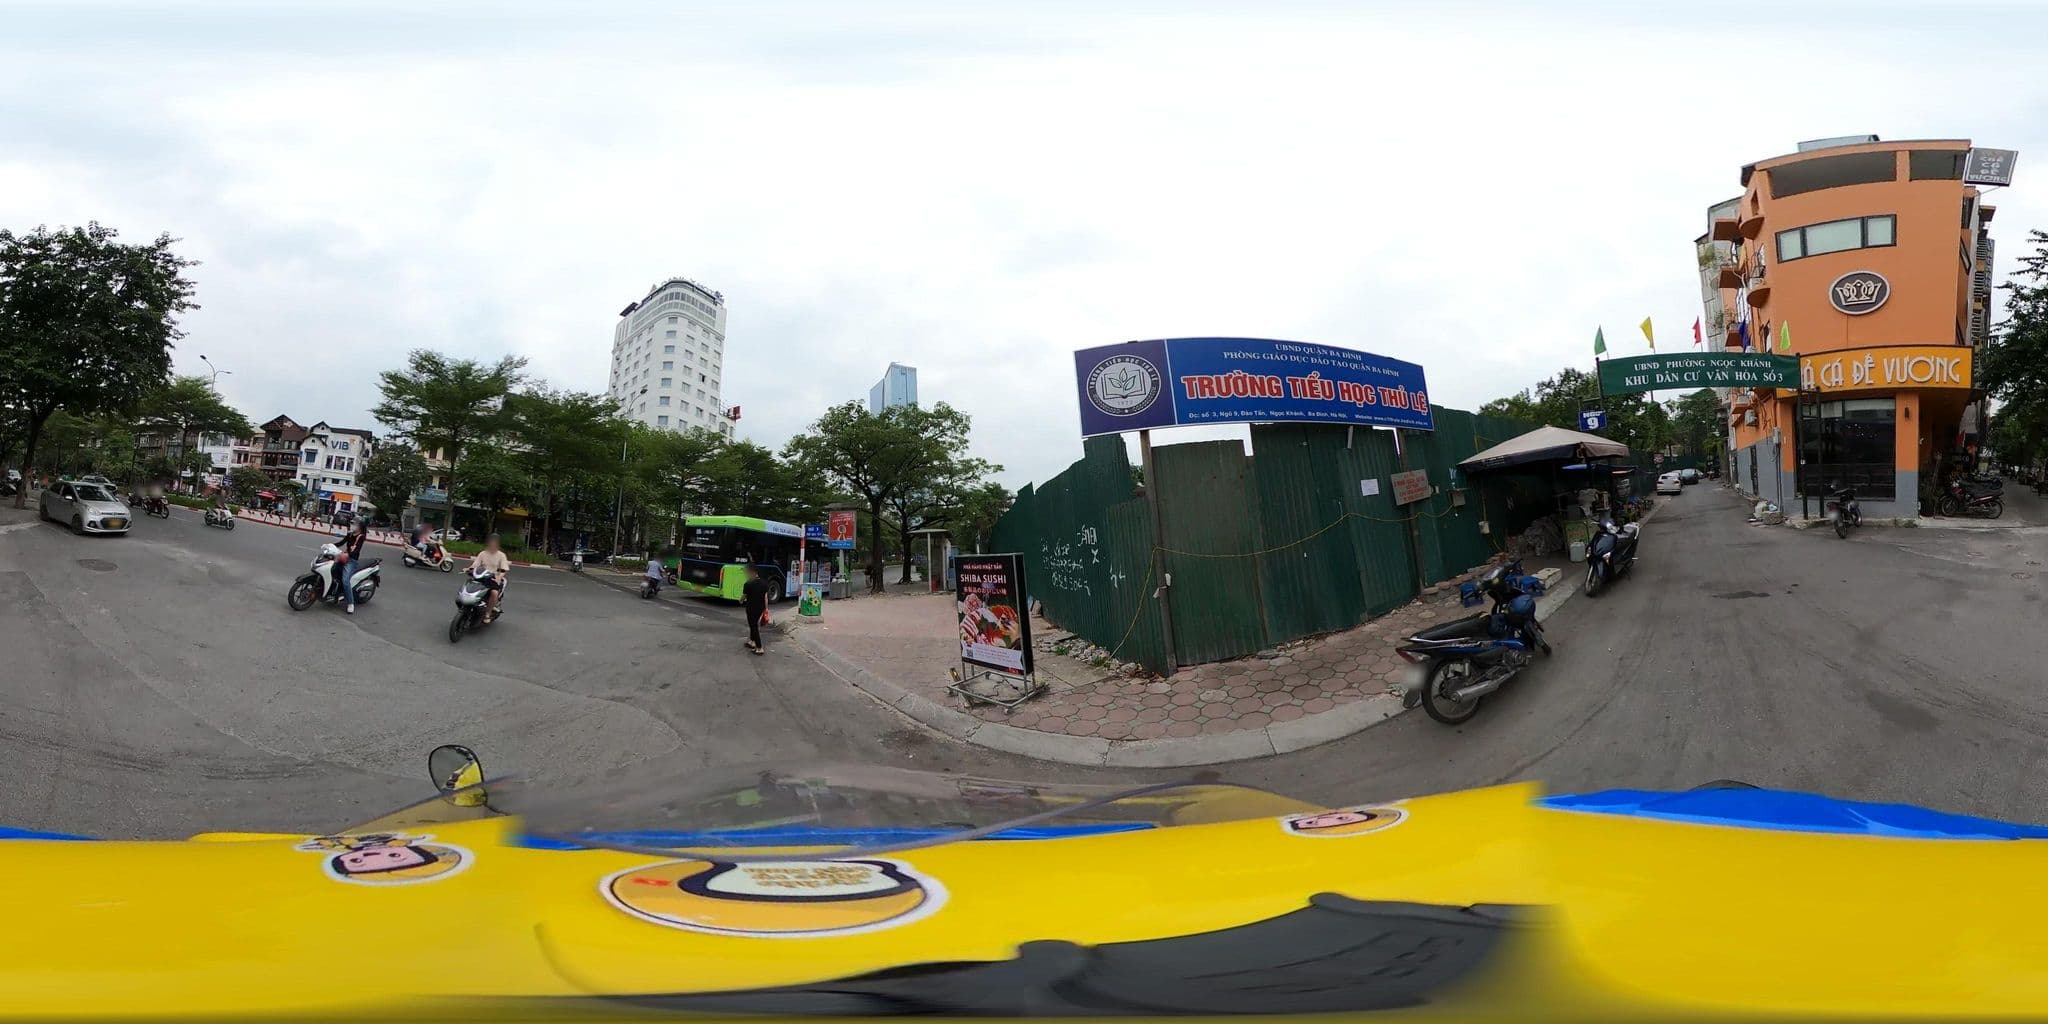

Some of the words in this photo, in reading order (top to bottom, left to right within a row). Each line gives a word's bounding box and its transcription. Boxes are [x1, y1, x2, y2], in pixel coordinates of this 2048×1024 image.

[1275, 343, 1302, 352] UBND
[1303, 346, 1328, 355] QUẬN
[1222, 350, 1260, 360] PHÒNG
[1262, 351, 1288, 361] GIÁO
[1666, 359, 1705, 368] PHƯỜNG
[1710, 359, 1735, 368] NGỌC
[1740, 358, 1772, 368] KHÁNH
[1820, 357, 1844, 387] CÁ
[1852, 352, 1876, 385] ĐẾ
[1883, 354, 1961, 384] VƯƠNG
[1625, 374, 1650, 386] KHU
[1656, 370, 1679, 383] DÂN
[1683, 370, 1701, 381] CƯ
[1707, 370, 1729, 381] VĂN
[1763, 368, 1777, 382] SỐ
[1777, 374, 1783, 382] 3
[1181, 369, 1284, 400] TRƯỜNG
[1287, 371, 1335, 400] TIỂU
[1338, 380, 1377, 407] HỌC
[1378, 384, 1408, 410] THỦ
[1410, 390, 1429, 415] LỆ
[1587, 417, 1599, 429] 9
[331, 440, 349, 451] VIB
[960, 573, 982, 583] SHIBA
[982, 574, 1007, 584] SUSHI
